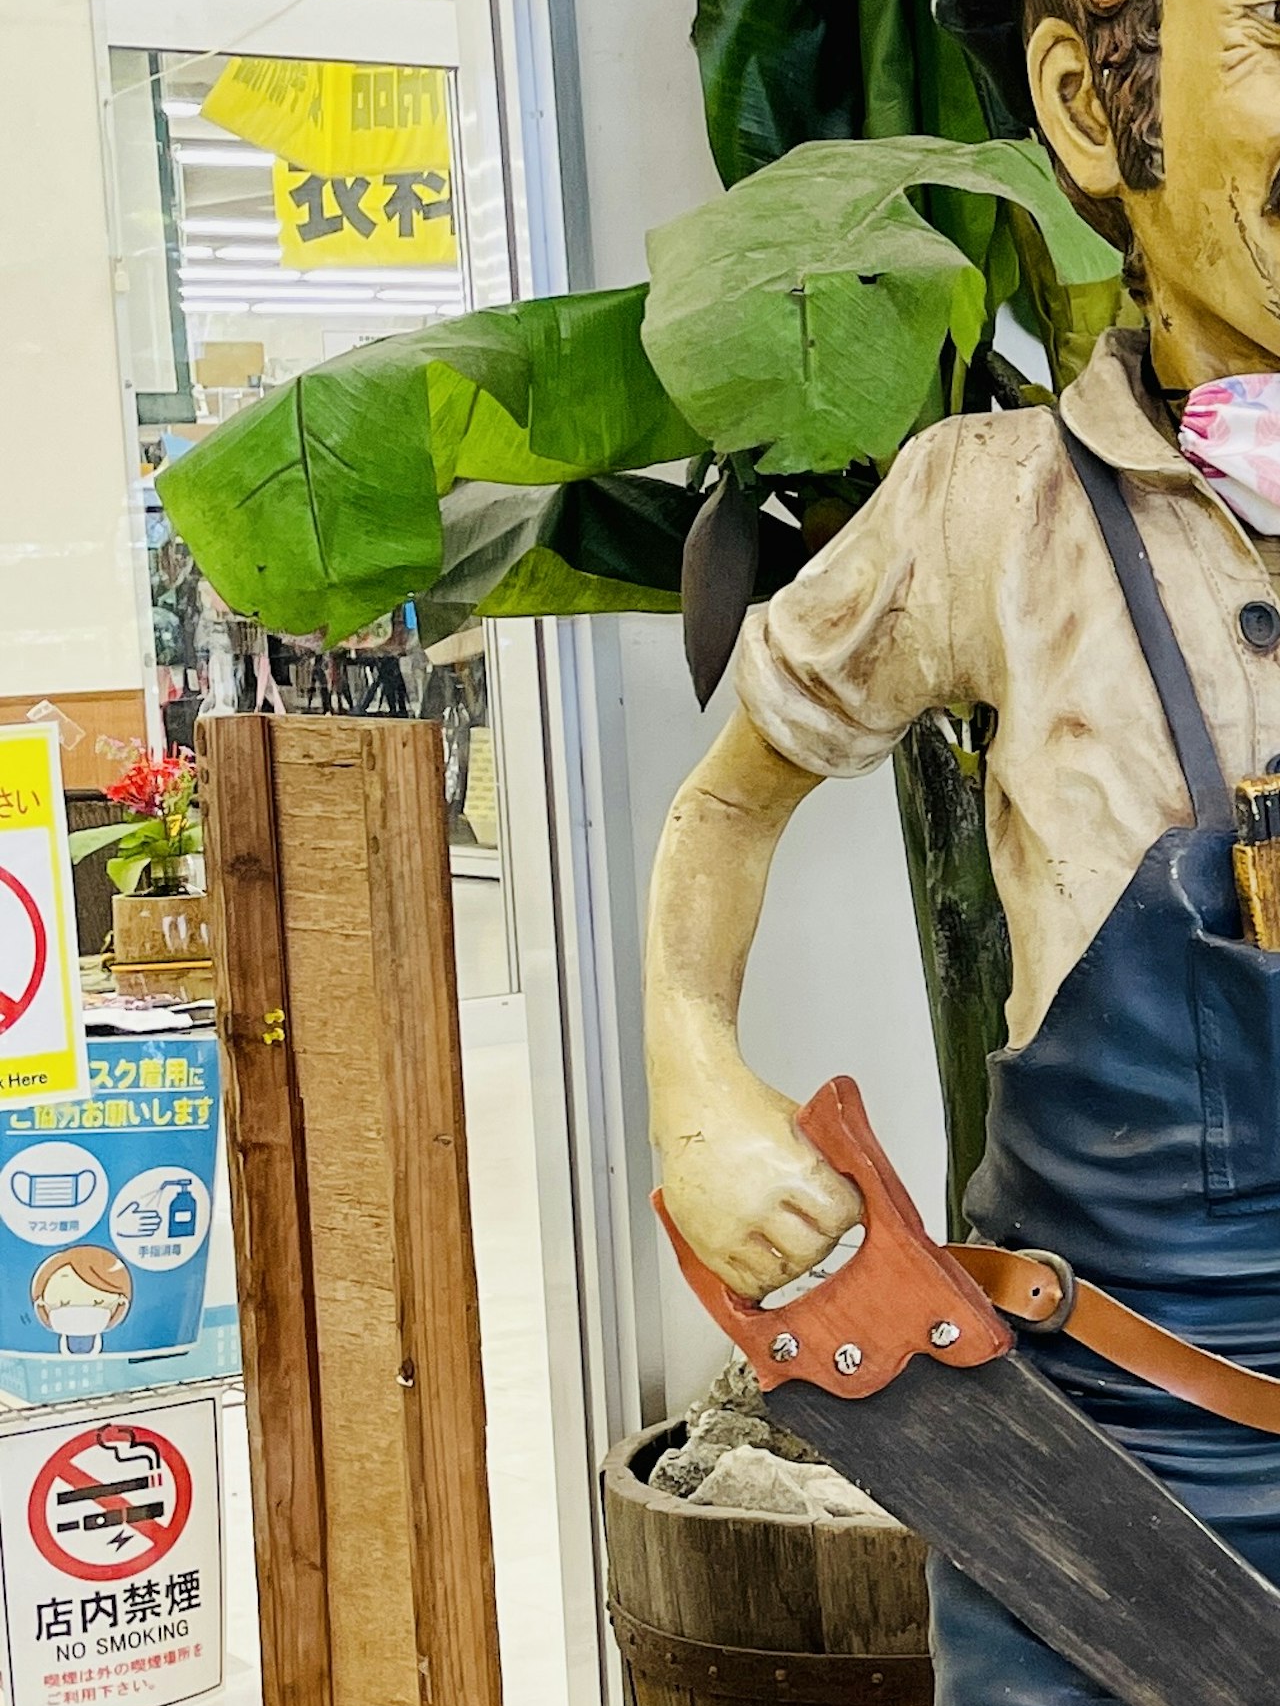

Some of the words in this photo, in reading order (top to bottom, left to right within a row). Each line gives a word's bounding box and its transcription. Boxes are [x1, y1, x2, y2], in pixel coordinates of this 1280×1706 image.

[9, 1073, 48, 1089] Here
[89, 1058, 205, 1089] スク着用に
[29, 1219, 80, 1232] マスク着用
[36, 1569, 202, 1642] 店内禁煙
[56, 1641, 87, 1663] NO
[96, 1619, 190, 1656] SMOKING
[43, 1643, 204, 1688] 喫煙は外の喫煙場所を
